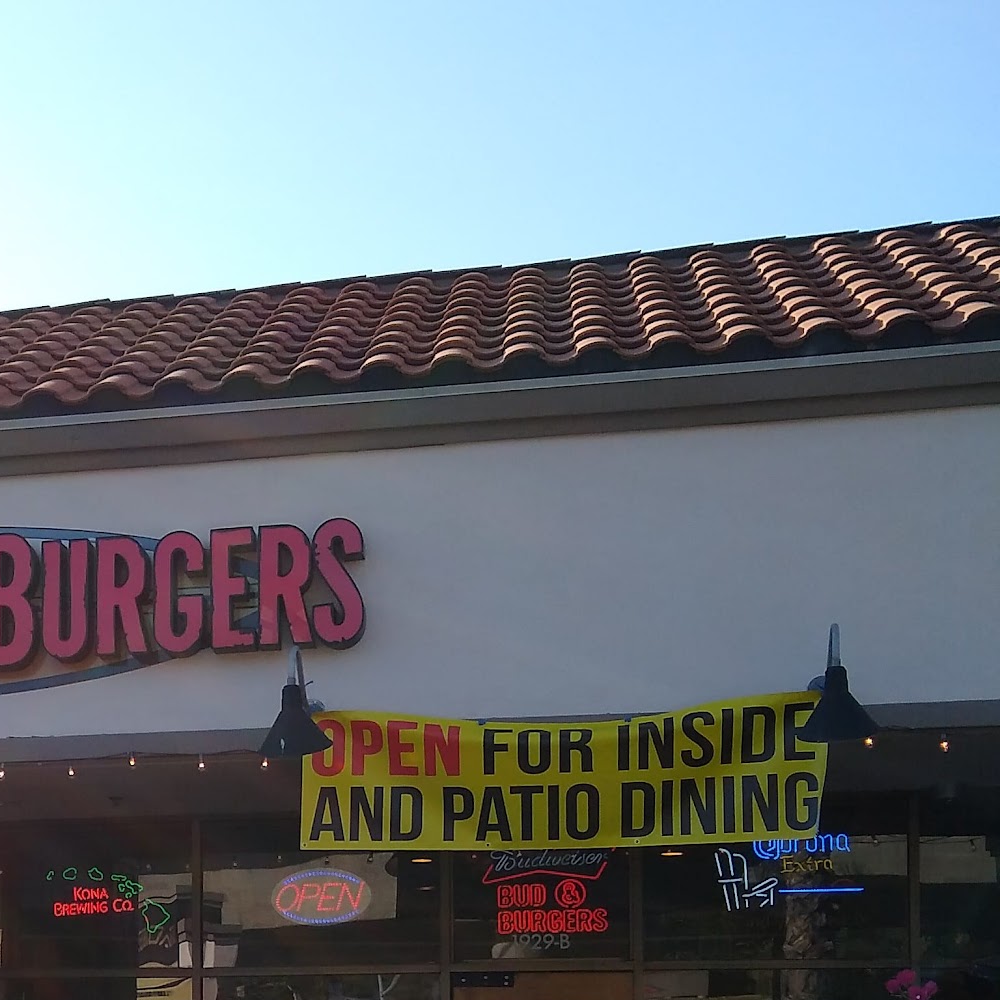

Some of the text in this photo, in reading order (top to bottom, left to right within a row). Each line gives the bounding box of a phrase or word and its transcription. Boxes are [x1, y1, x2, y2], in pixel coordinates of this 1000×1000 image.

[311, 701, 816, 777] OPEN FOR INSIDE
[309, 771, 821, 842] AND PATIO DINING
[73, 886, 109, 900] KONA
[275, 881, 365, 912] OPEN
[497, 884, 547, 908] BUD
[53, 902, 109, 917] BREWING
[497, 908, 609, 935] BURGERS
